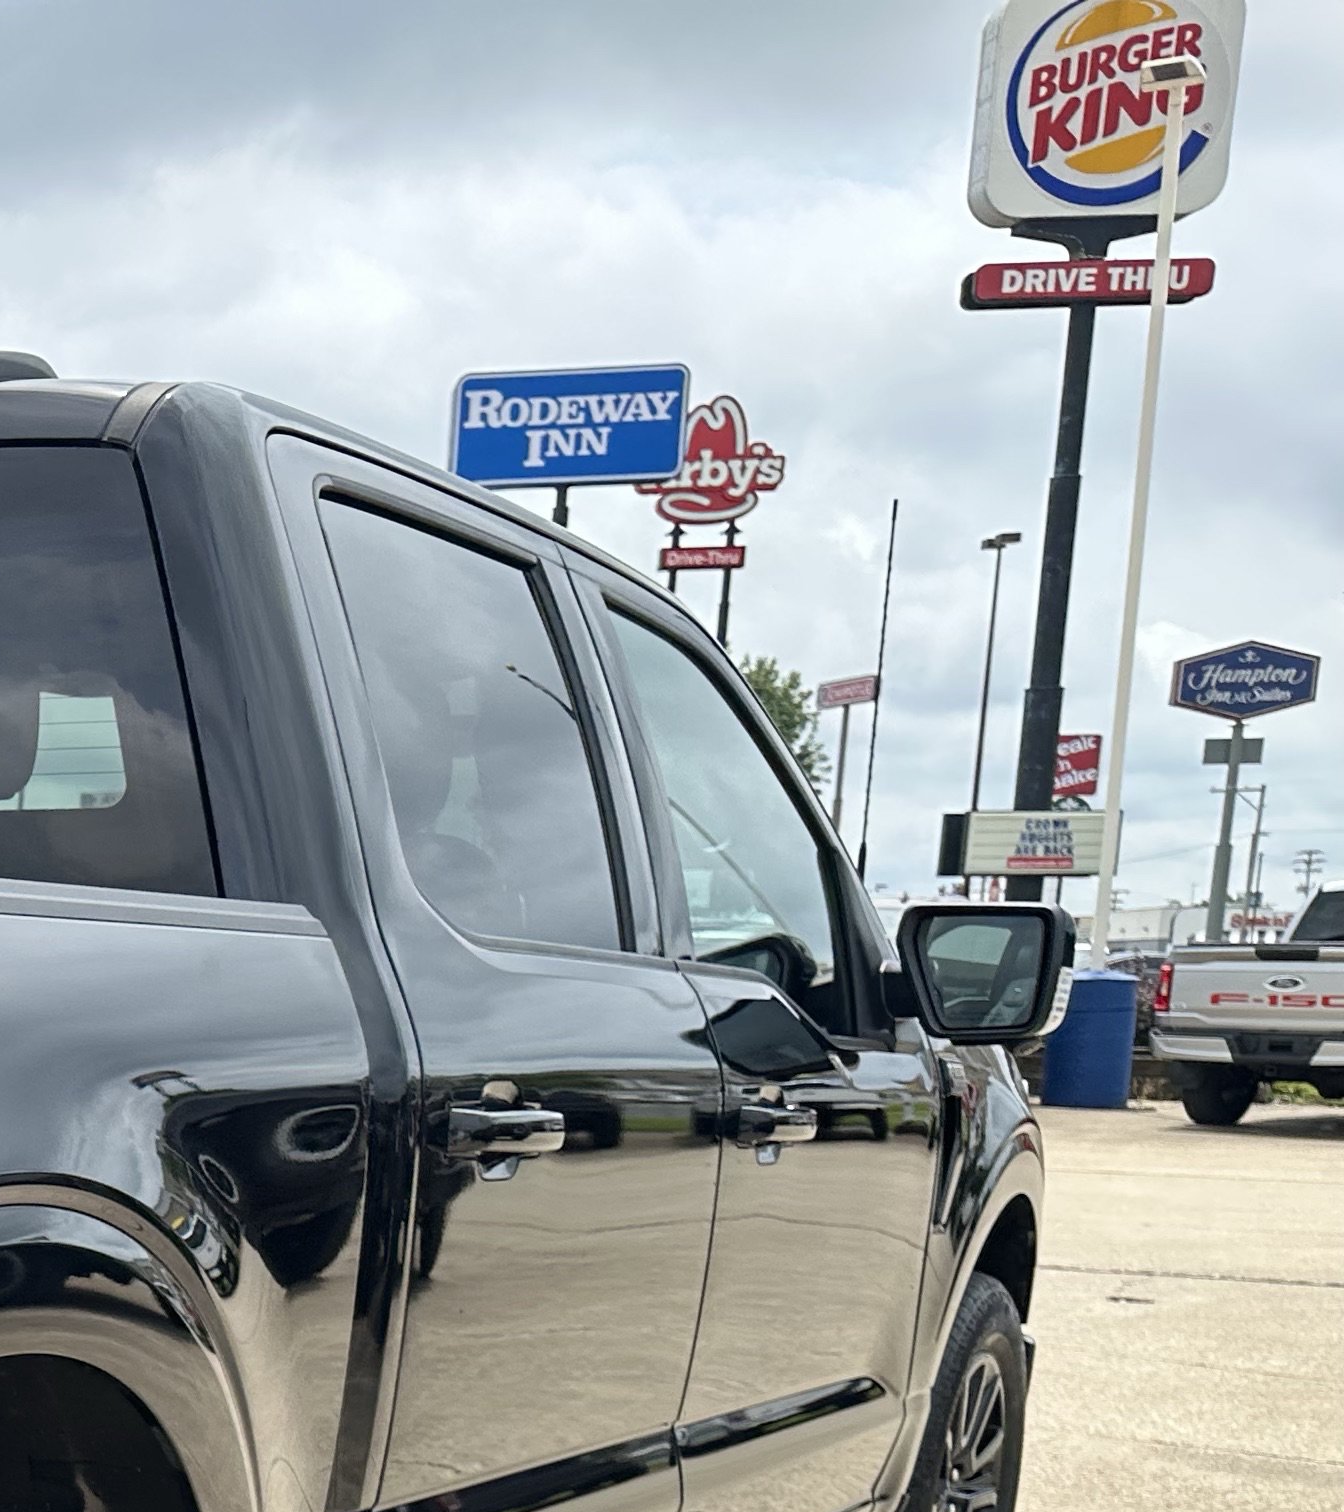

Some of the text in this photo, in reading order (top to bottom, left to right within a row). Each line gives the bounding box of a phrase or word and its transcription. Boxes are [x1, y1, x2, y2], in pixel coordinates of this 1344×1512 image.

[1028, 22, 1203, 109] BURGER
[1001, 265, 1190, 294] DRIVE THU
[463, 388, 679, 429] RODEWAY
[523, 427, 611, 467] INN
[662, 446, 783, 497] rby's
[1187, 662, 1307, 691] Hampton
[1196, 688, 1234, 706] Inn
[1248, 686, 1292, 703] Suites
[1057, 736, 1097, 757] eak
[1055, 767, 1098, 791] ake
[1043, 844, 1074, 855] BACK
